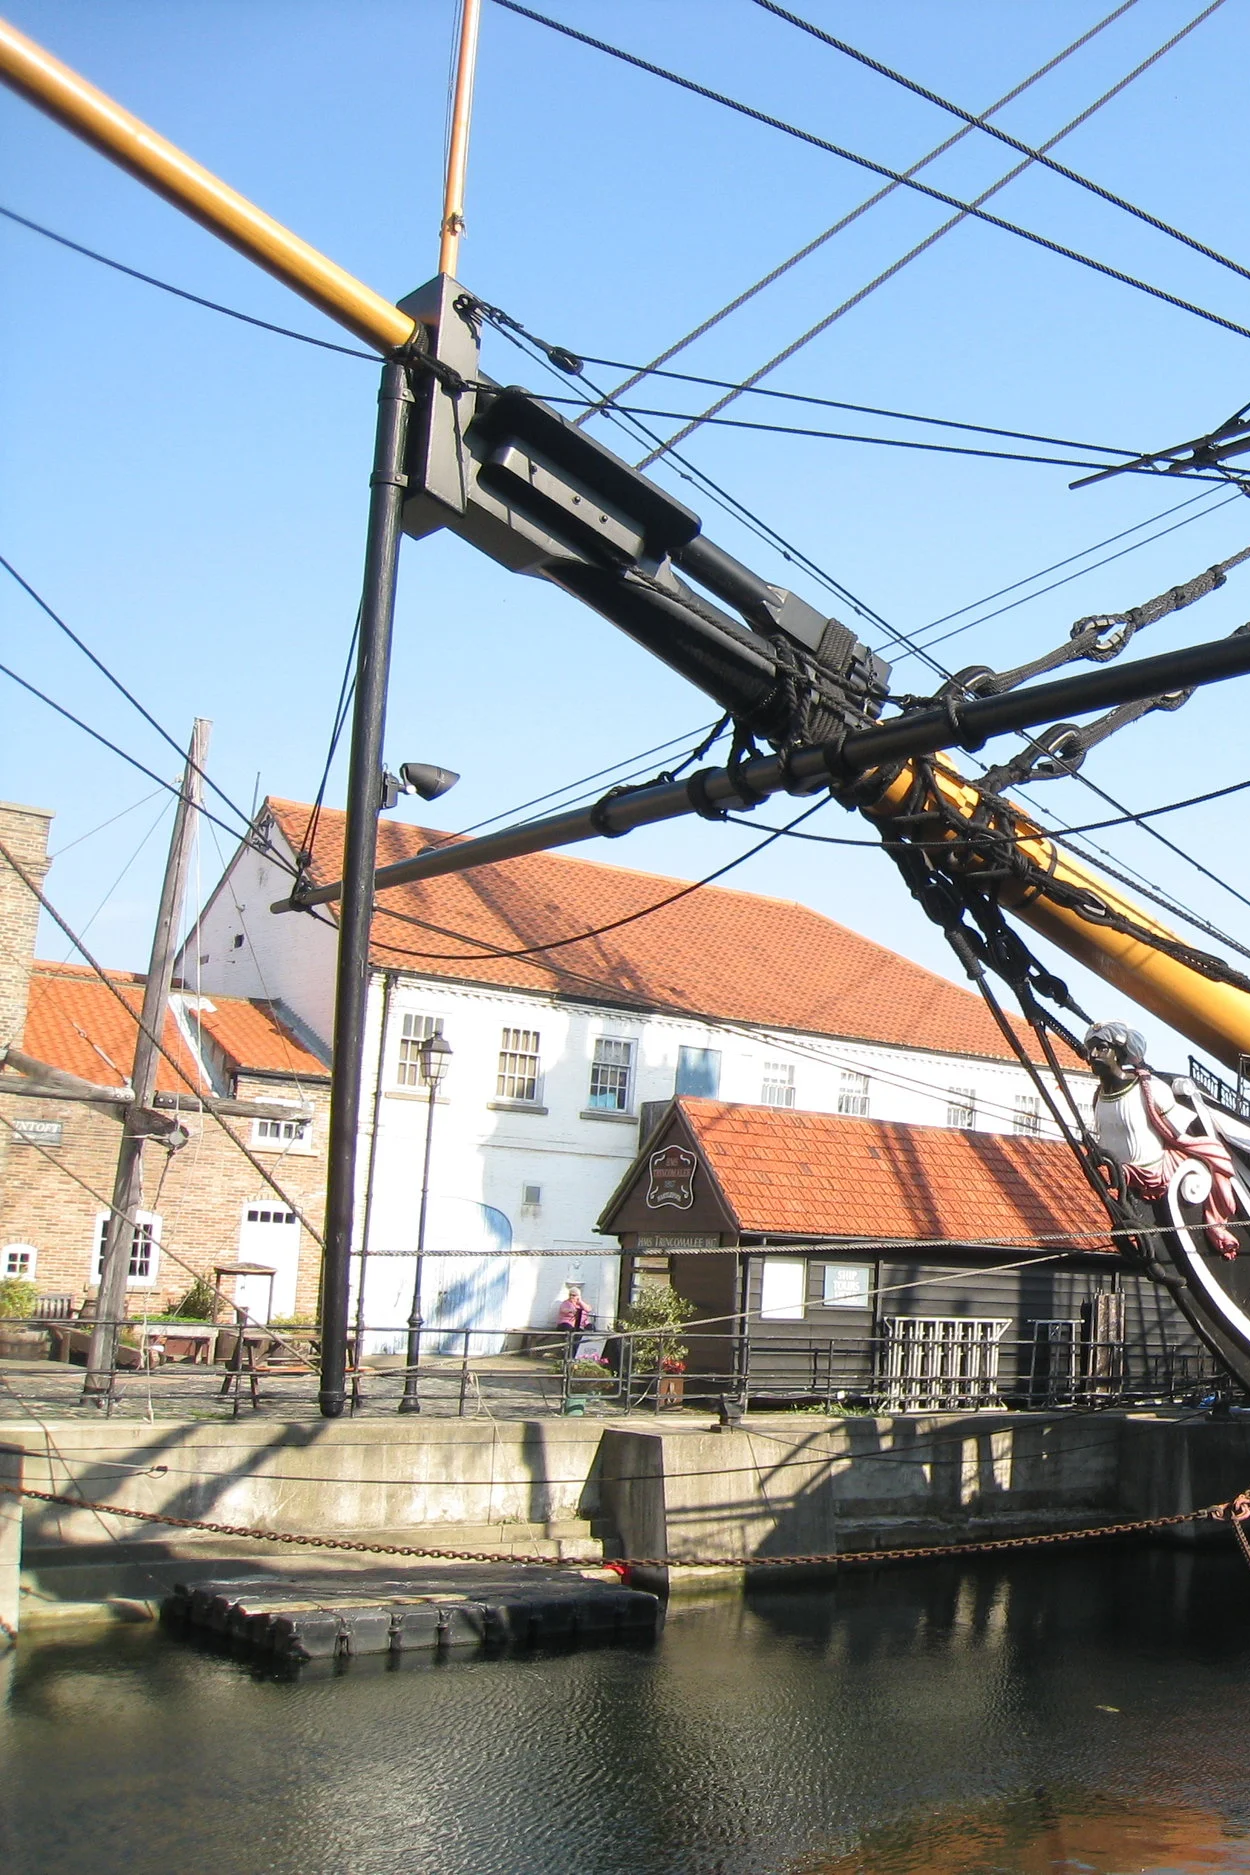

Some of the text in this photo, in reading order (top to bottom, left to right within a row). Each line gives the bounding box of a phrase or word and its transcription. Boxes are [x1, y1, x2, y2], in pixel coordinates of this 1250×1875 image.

[638, 1237, 652, 1247] HMS
[655, 1235, 703, 1248] TRINCOMALEE
[837, 1270, 857, 1280] SHIP
[833, 1281, 860, 1291] TOURS
